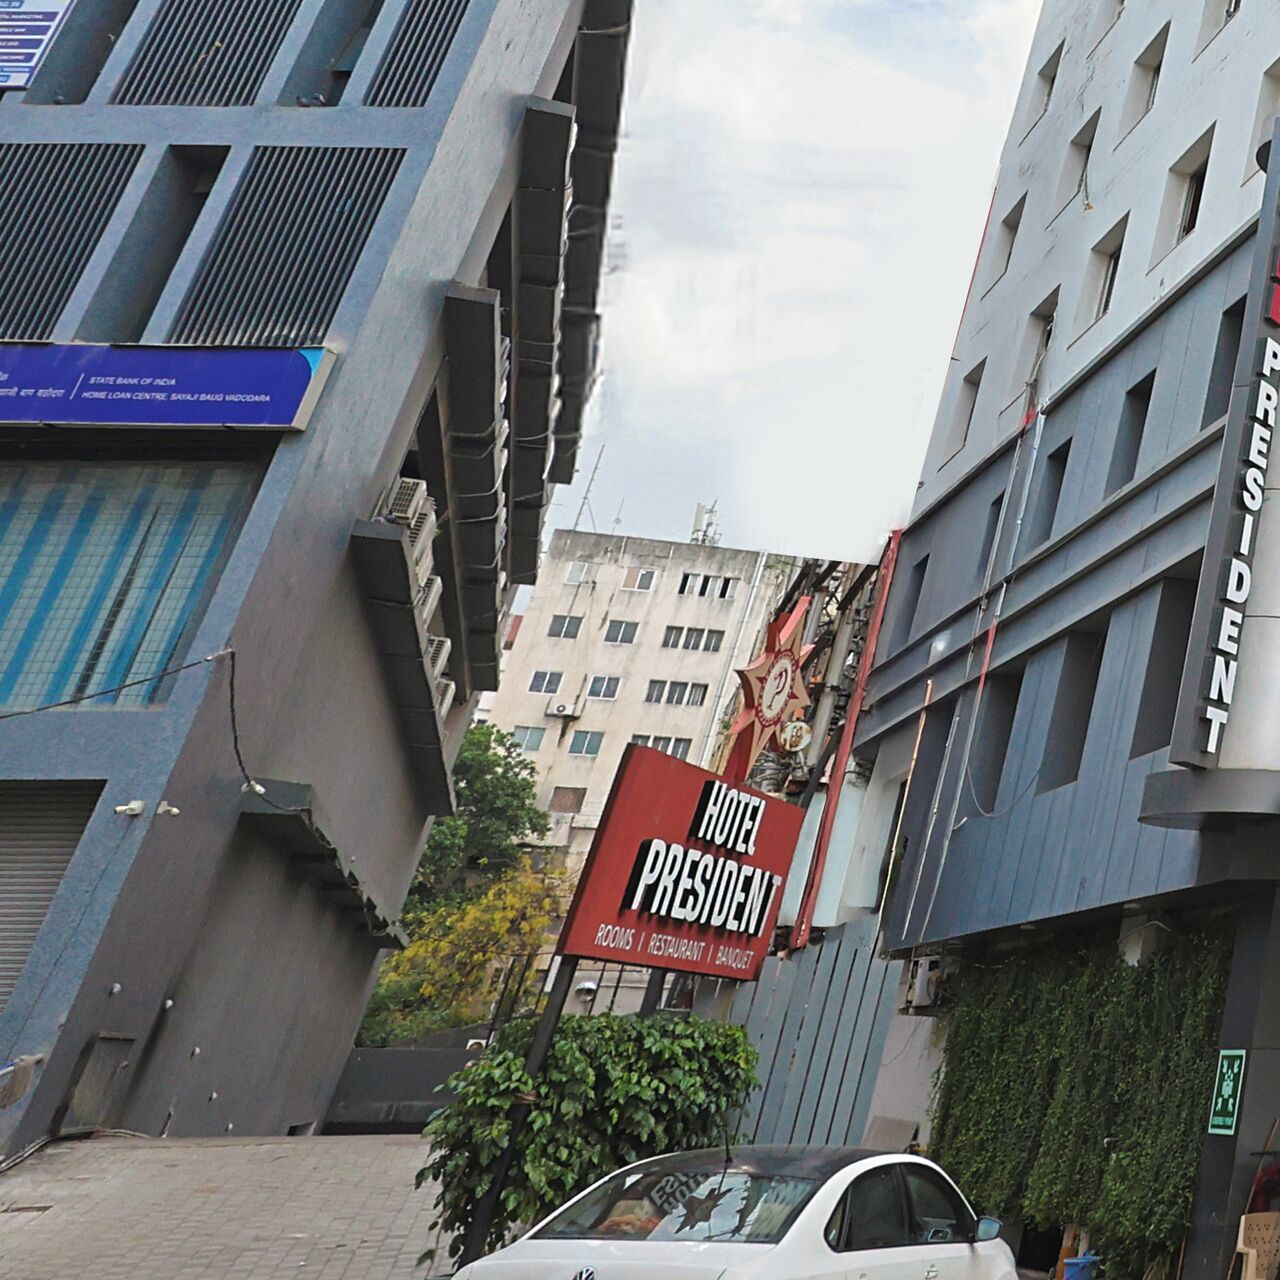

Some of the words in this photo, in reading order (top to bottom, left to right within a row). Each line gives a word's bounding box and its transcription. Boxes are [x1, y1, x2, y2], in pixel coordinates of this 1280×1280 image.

[81, 391, 107, 399] HOME
[108, 392, 131, 400] LOAN
[171, 393, 198, 401] SAYAJI
[199, 393, 223, 401] BAUG
[225, 394, 271, 402] VADODARA
[90, 376, 115, 385] STATE
[116, 377, 139, 385] BANK
[153, 378, 176, 386] INDIA
[698, 780, 766, 856] HOTEL
[631, 838, 783, 938] PRESIDENT
[594, 923, 635, 950] ROOMS
[648, 932, 706, 963] RESTAURANT
[715, 943, 754, 970] BANQUET
